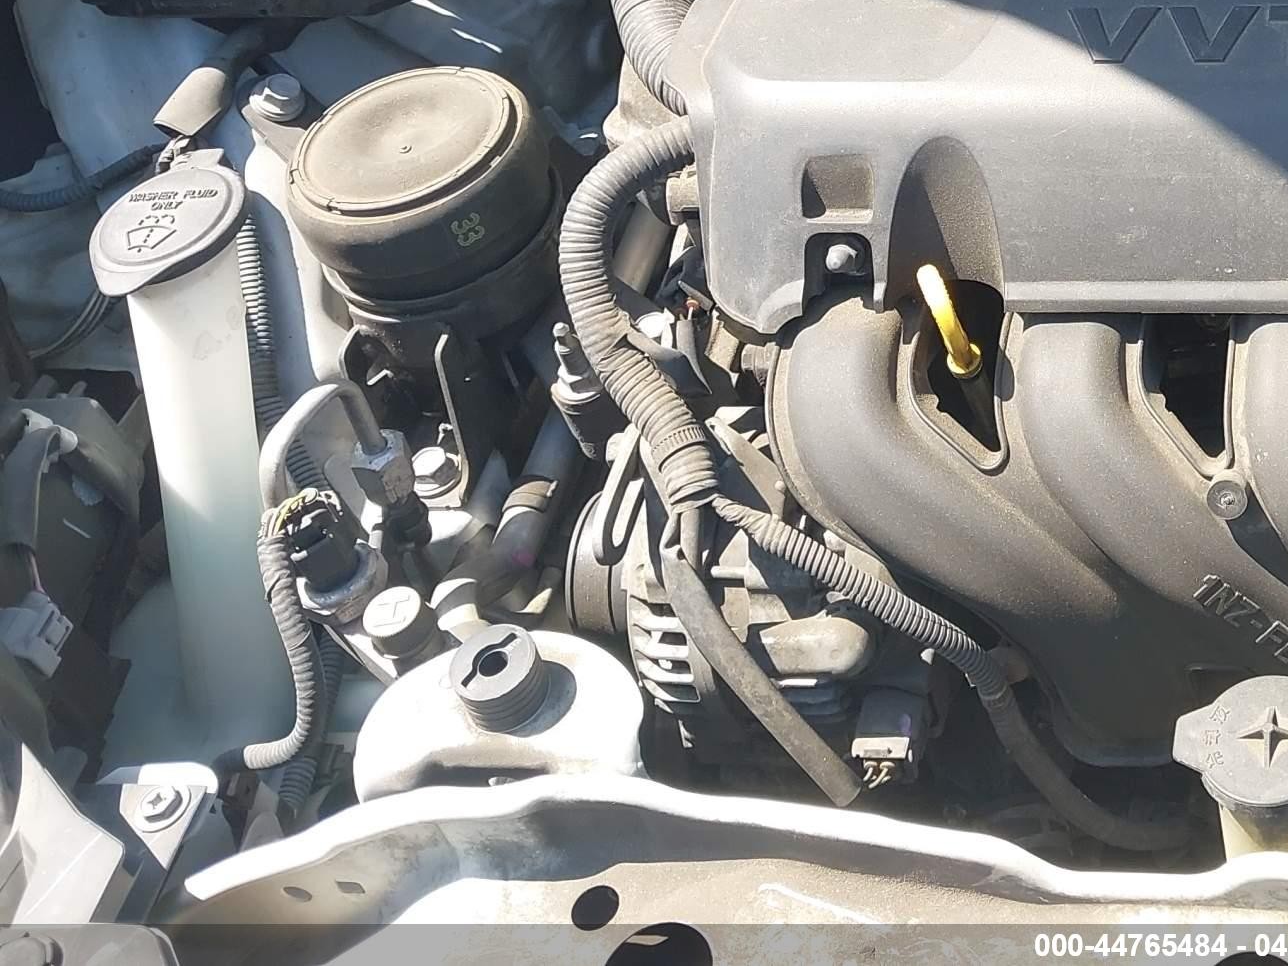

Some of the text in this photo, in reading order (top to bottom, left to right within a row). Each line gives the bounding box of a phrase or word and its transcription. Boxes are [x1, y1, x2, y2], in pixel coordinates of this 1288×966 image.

[129, 189, 218, 202] WASHER FLUID
[151, 201, 184, 211] ONLY
